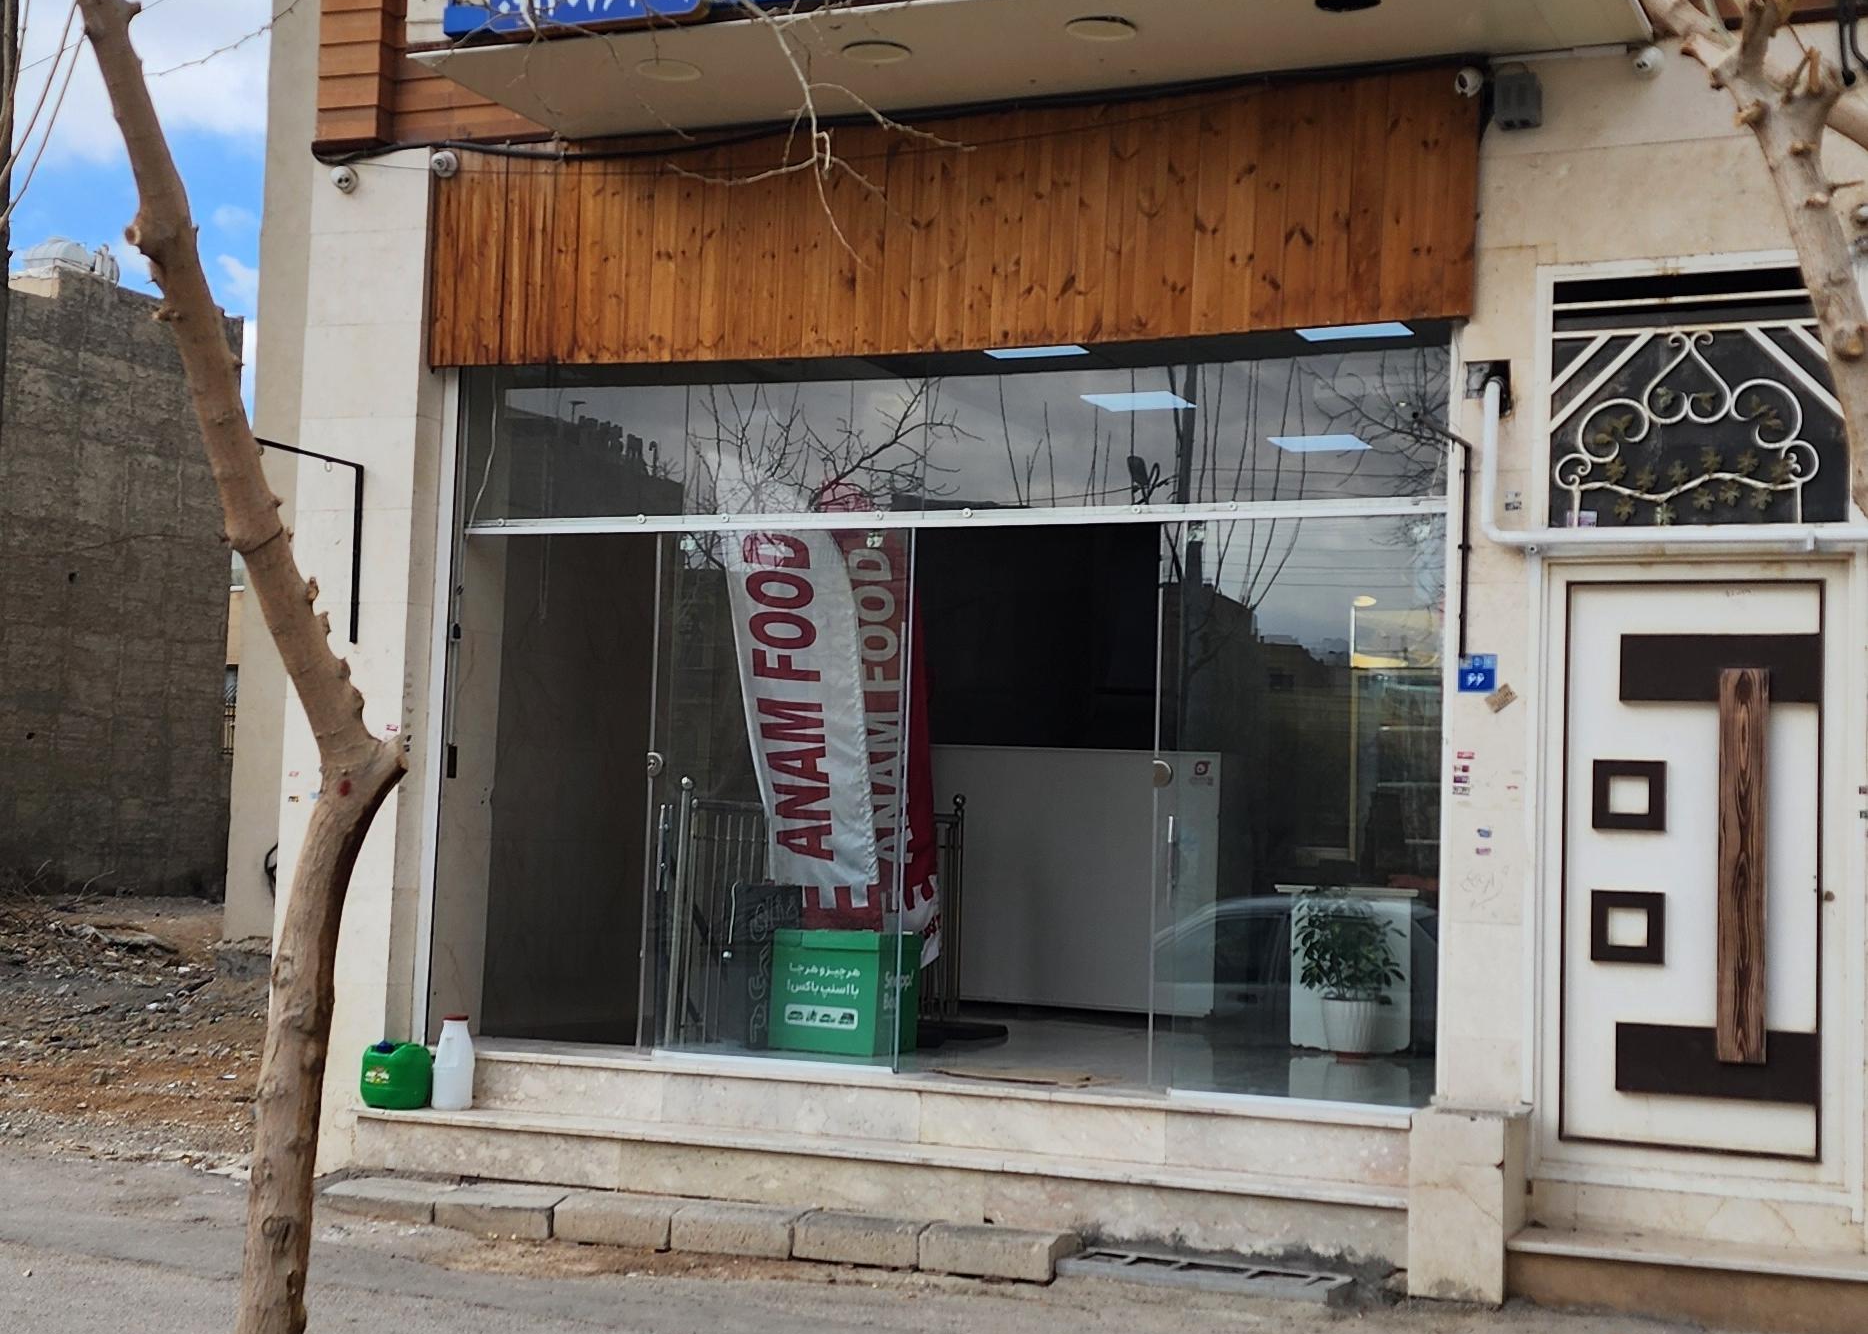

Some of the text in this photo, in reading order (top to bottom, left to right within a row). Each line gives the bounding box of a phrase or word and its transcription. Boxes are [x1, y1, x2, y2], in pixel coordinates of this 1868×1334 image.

[744, 533, 821, 682] FOOD
[758, 699, 834, 862] ANAM
[850, 548, 913, 864] ANAM FOOD
[883, 969, 914, 992] Snpp!
